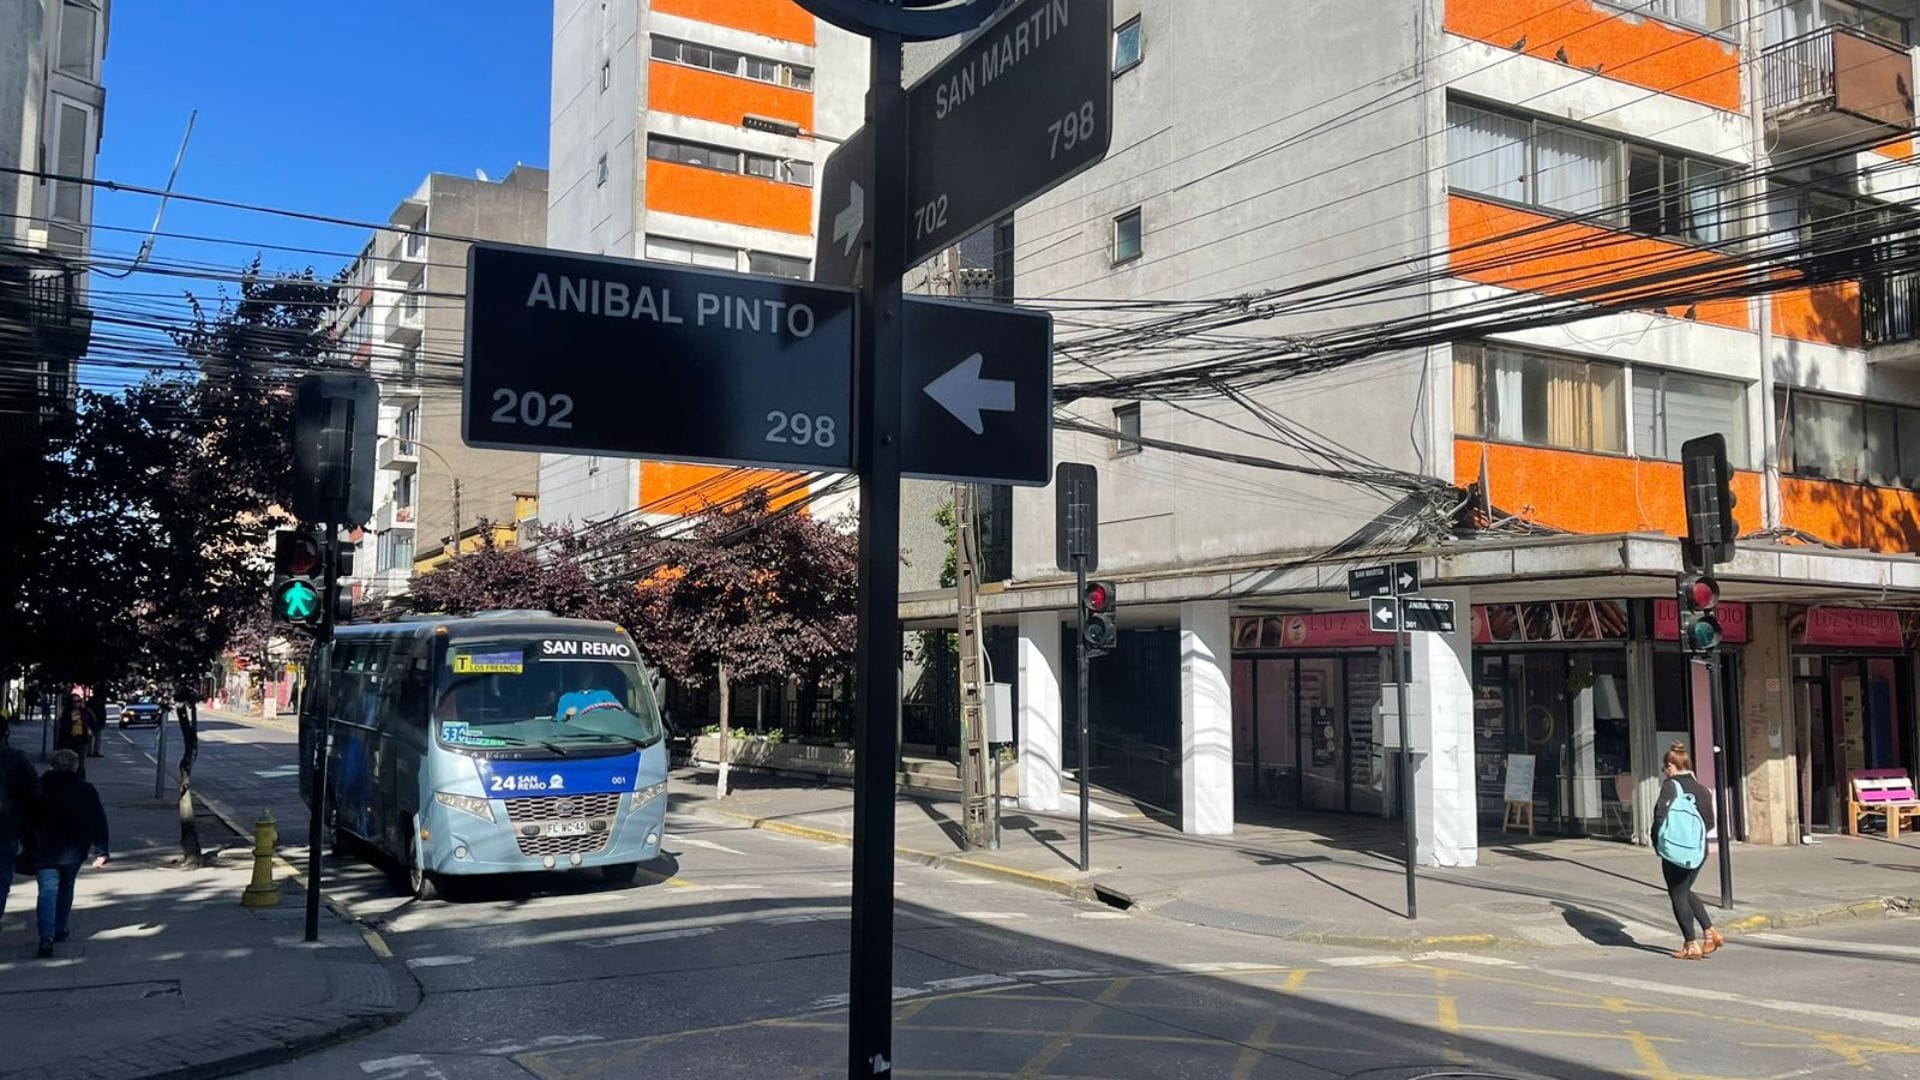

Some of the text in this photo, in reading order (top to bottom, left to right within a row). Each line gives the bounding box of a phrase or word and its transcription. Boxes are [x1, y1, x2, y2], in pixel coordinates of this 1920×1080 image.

[936, 0, 1069, 119] SAN MARTIN
[1048, 101, 1095, 160] 798
[914, 194, 948, 240] 702
[526, 272, 815, 339] ANIBAL PINTO
[491, 388, 574, 429] 202
[765, 410, 837, 449] 298
[1814, 609, 1894, 630] LUZ STUDIO
[456, 656, 468, 670] T
[543, 640, 630, 657] SAN REMO
[491, 776, 516, 791] 24
[517, 782, 546, 790] REMO
[611, 776, 626, 785] 001
